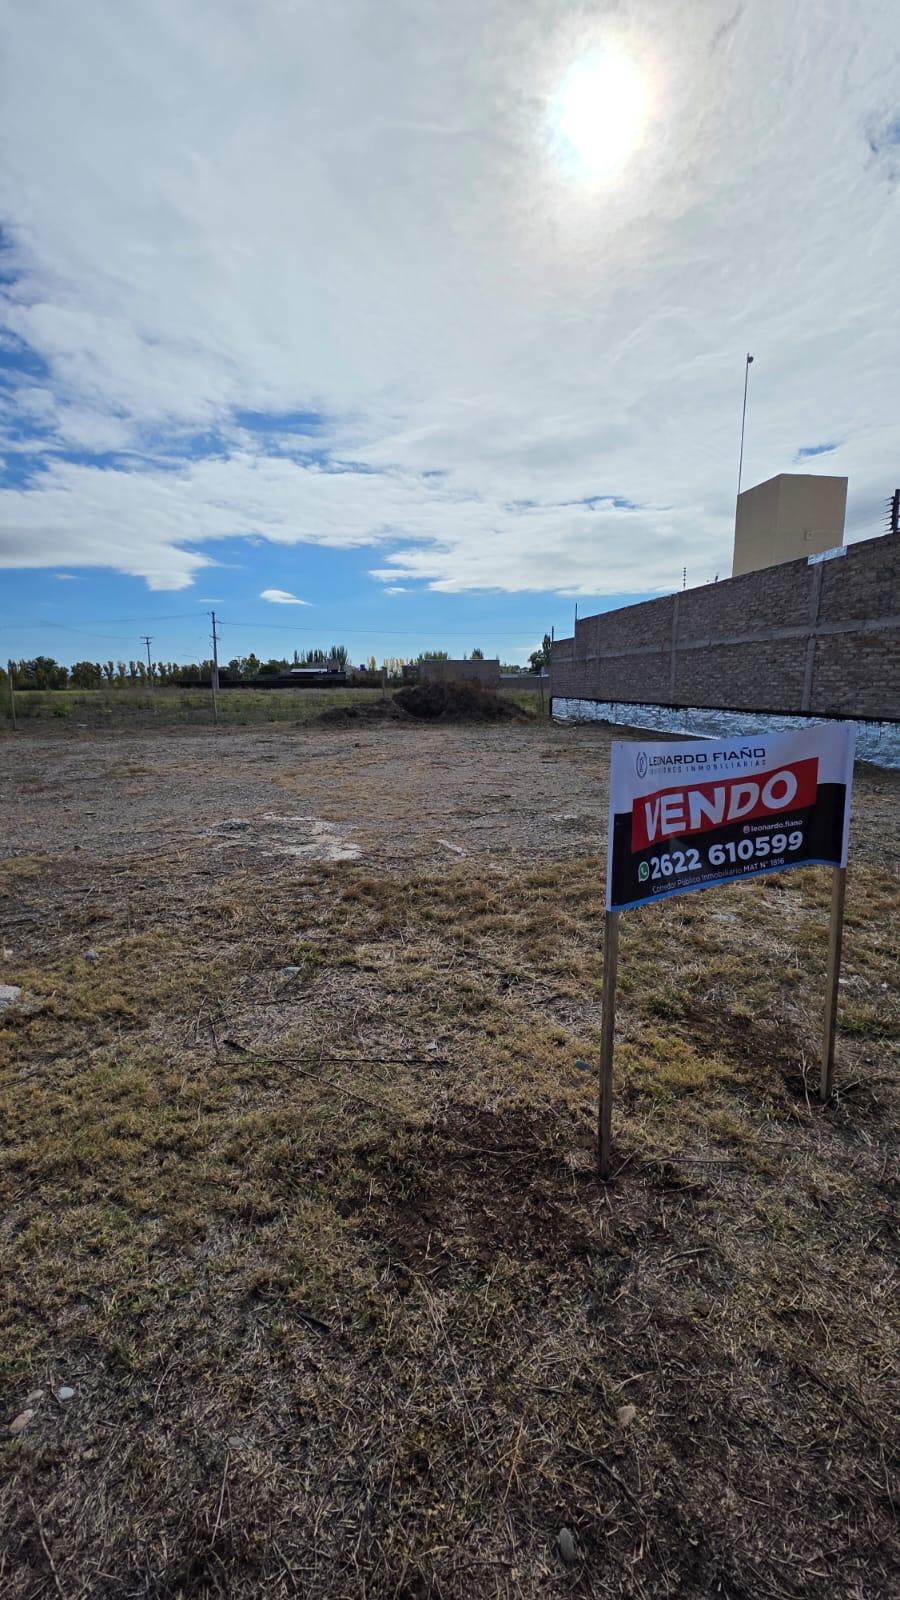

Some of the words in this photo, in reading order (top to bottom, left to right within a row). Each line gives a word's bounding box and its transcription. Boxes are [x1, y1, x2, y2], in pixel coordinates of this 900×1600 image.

[686, 759, 766, 773] INMOBILIARIAS
[712, 747, 766, 762] FIAÑO
[644, 770, 798, 842] VENDO
[650, 848, 702, 880] 2622
[708, 831, 803, 866] 610599
[651, 880, 677, 894] Corredor
[701, 868, 743, 881] Inmobiliario
[743, 862, 758, 872] MAT
